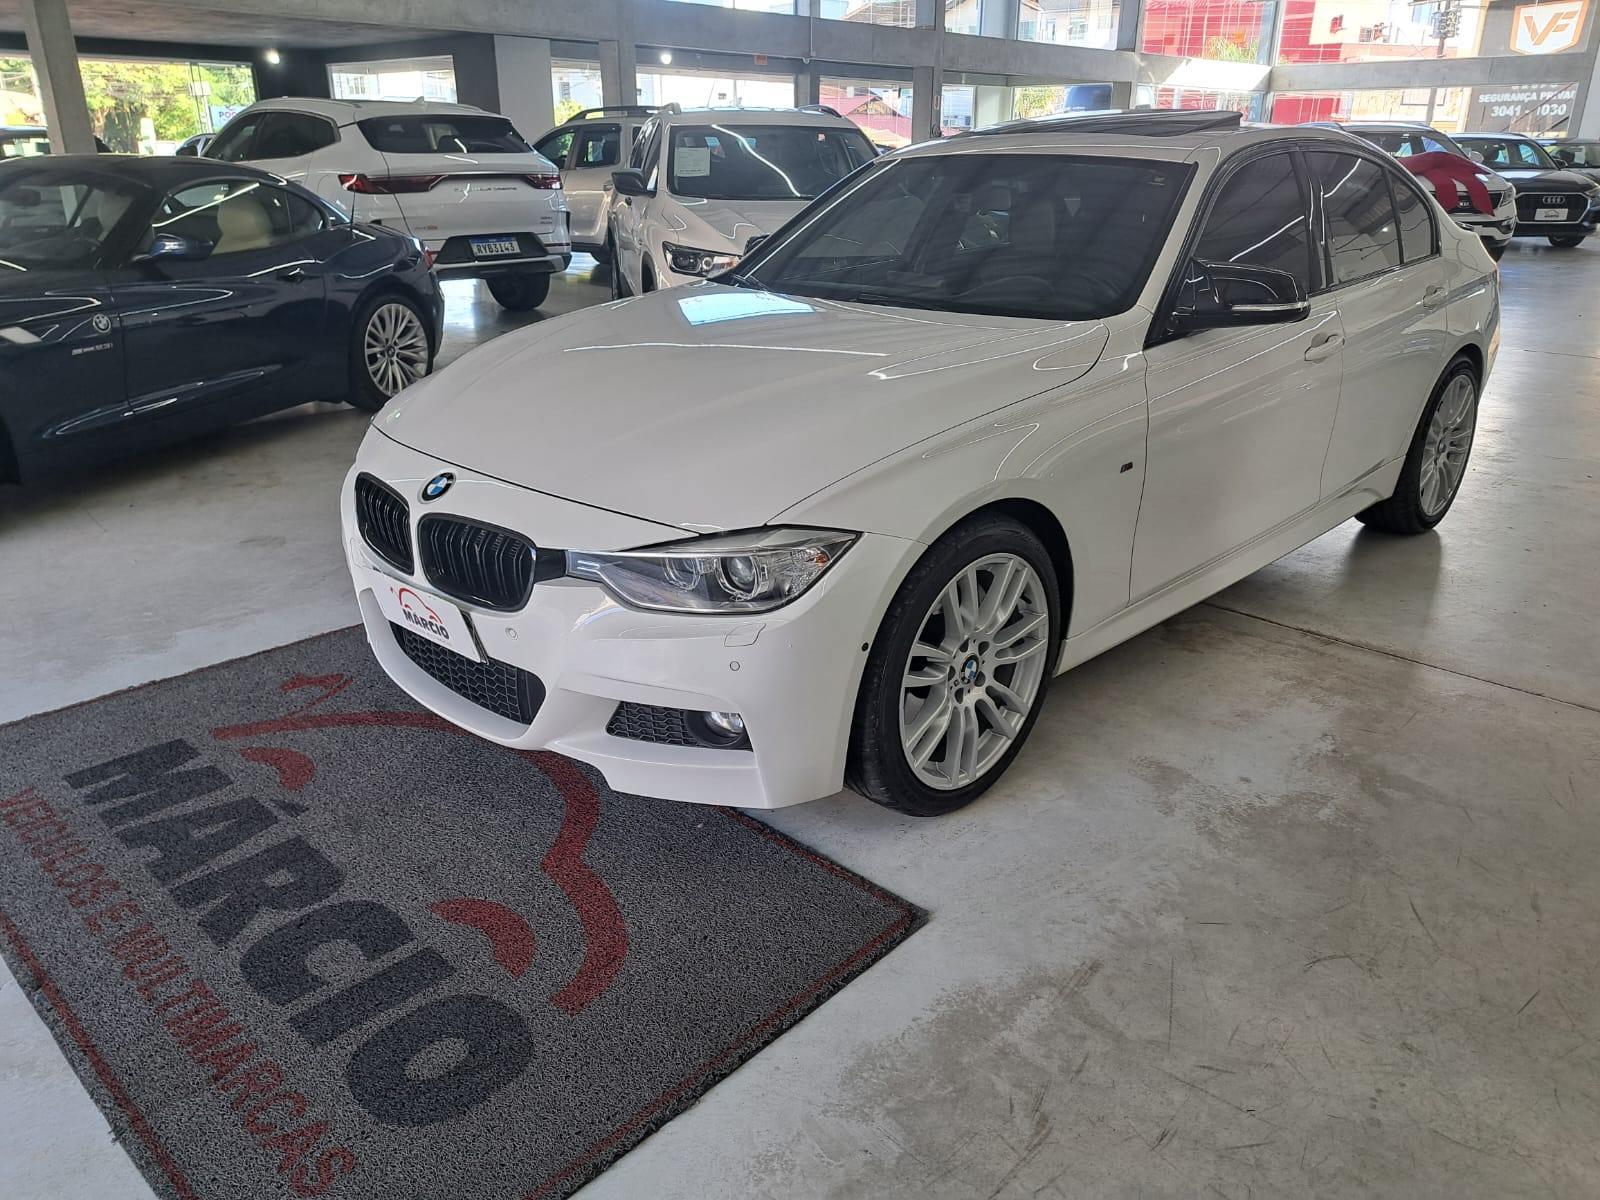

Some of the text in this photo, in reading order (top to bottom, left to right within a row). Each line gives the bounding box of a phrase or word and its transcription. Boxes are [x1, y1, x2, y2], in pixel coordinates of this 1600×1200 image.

[1479, 92, 1537, 102] SEGURANÇA
[1491, 105, 1521, 116] 3041
[1537, 103, 1566, 115] 1030
[107, 922, 355, 1197] MULTIMARCAS
